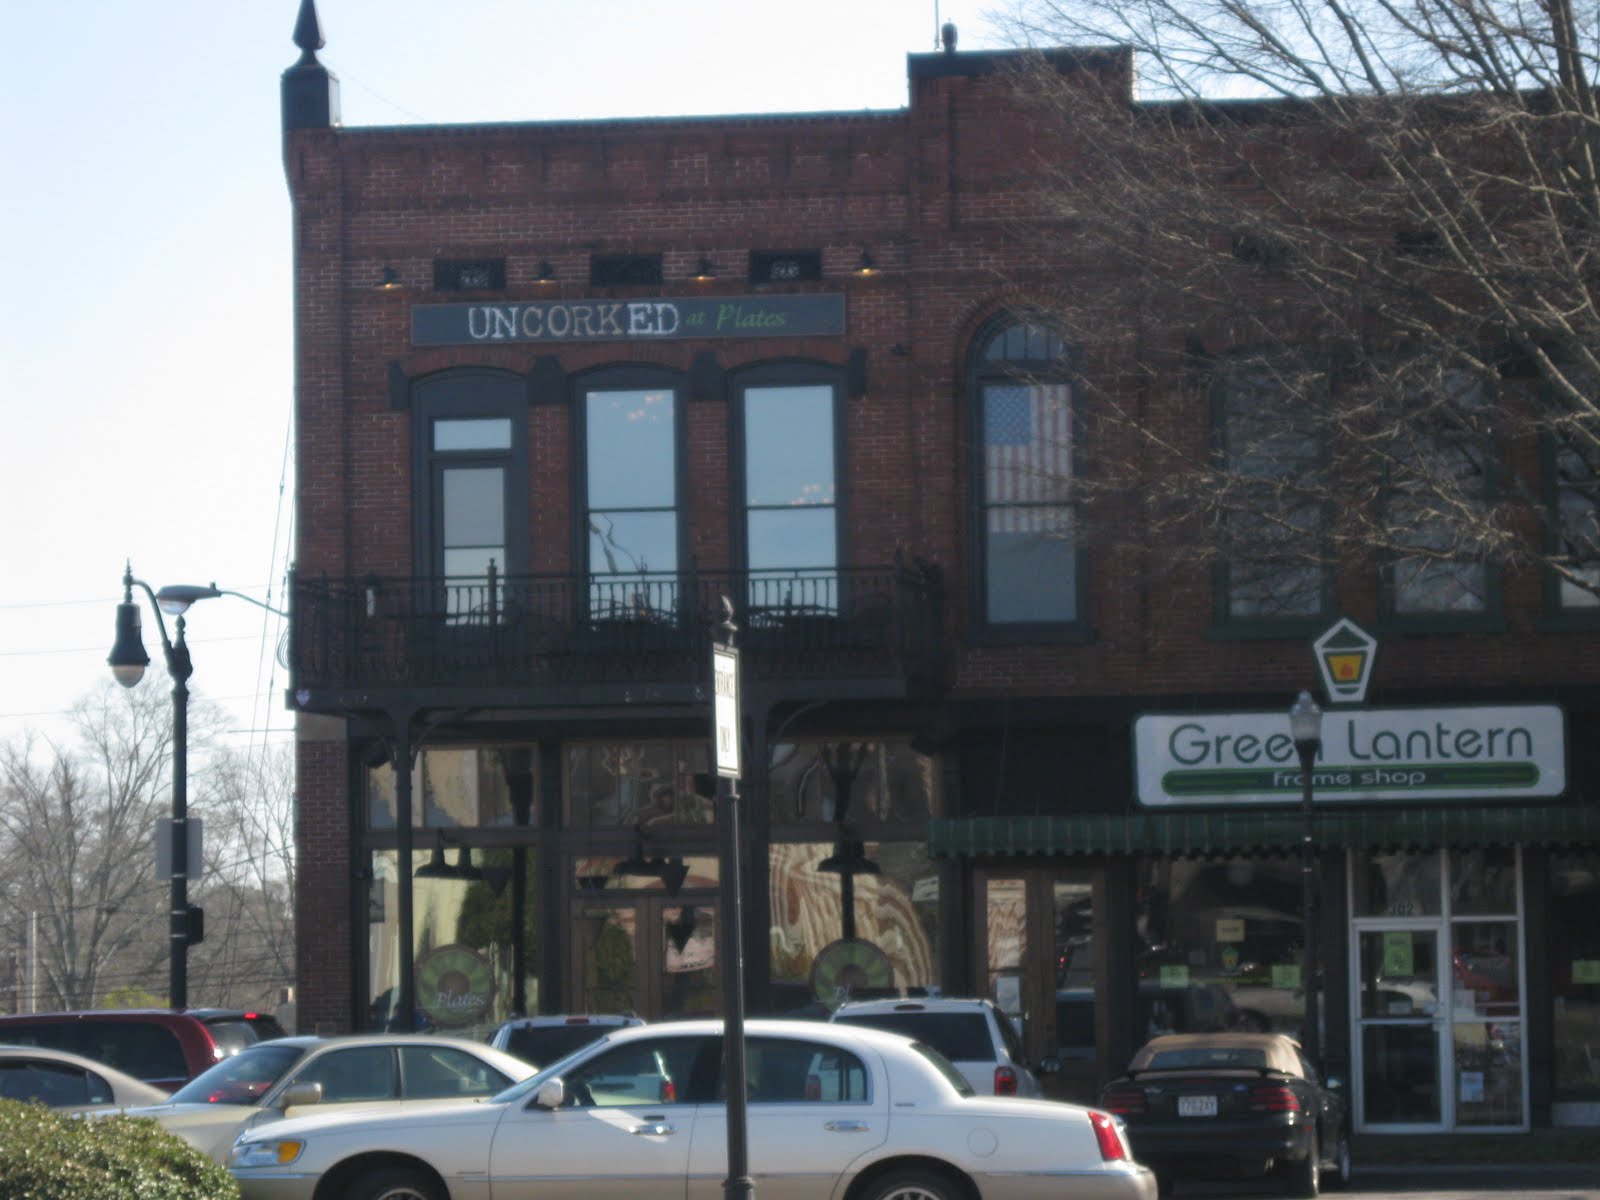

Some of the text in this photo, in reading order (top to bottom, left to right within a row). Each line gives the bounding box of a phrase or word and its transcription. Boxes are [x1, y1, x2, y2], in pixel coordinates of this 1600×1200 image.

[467, 302, 787, 340] UNCORKED at Plates
[1347, 719, 1534, 760] Lantern
[1360, 768, 1427, 787] shop
[435, 989, 485, 1009] Plates
